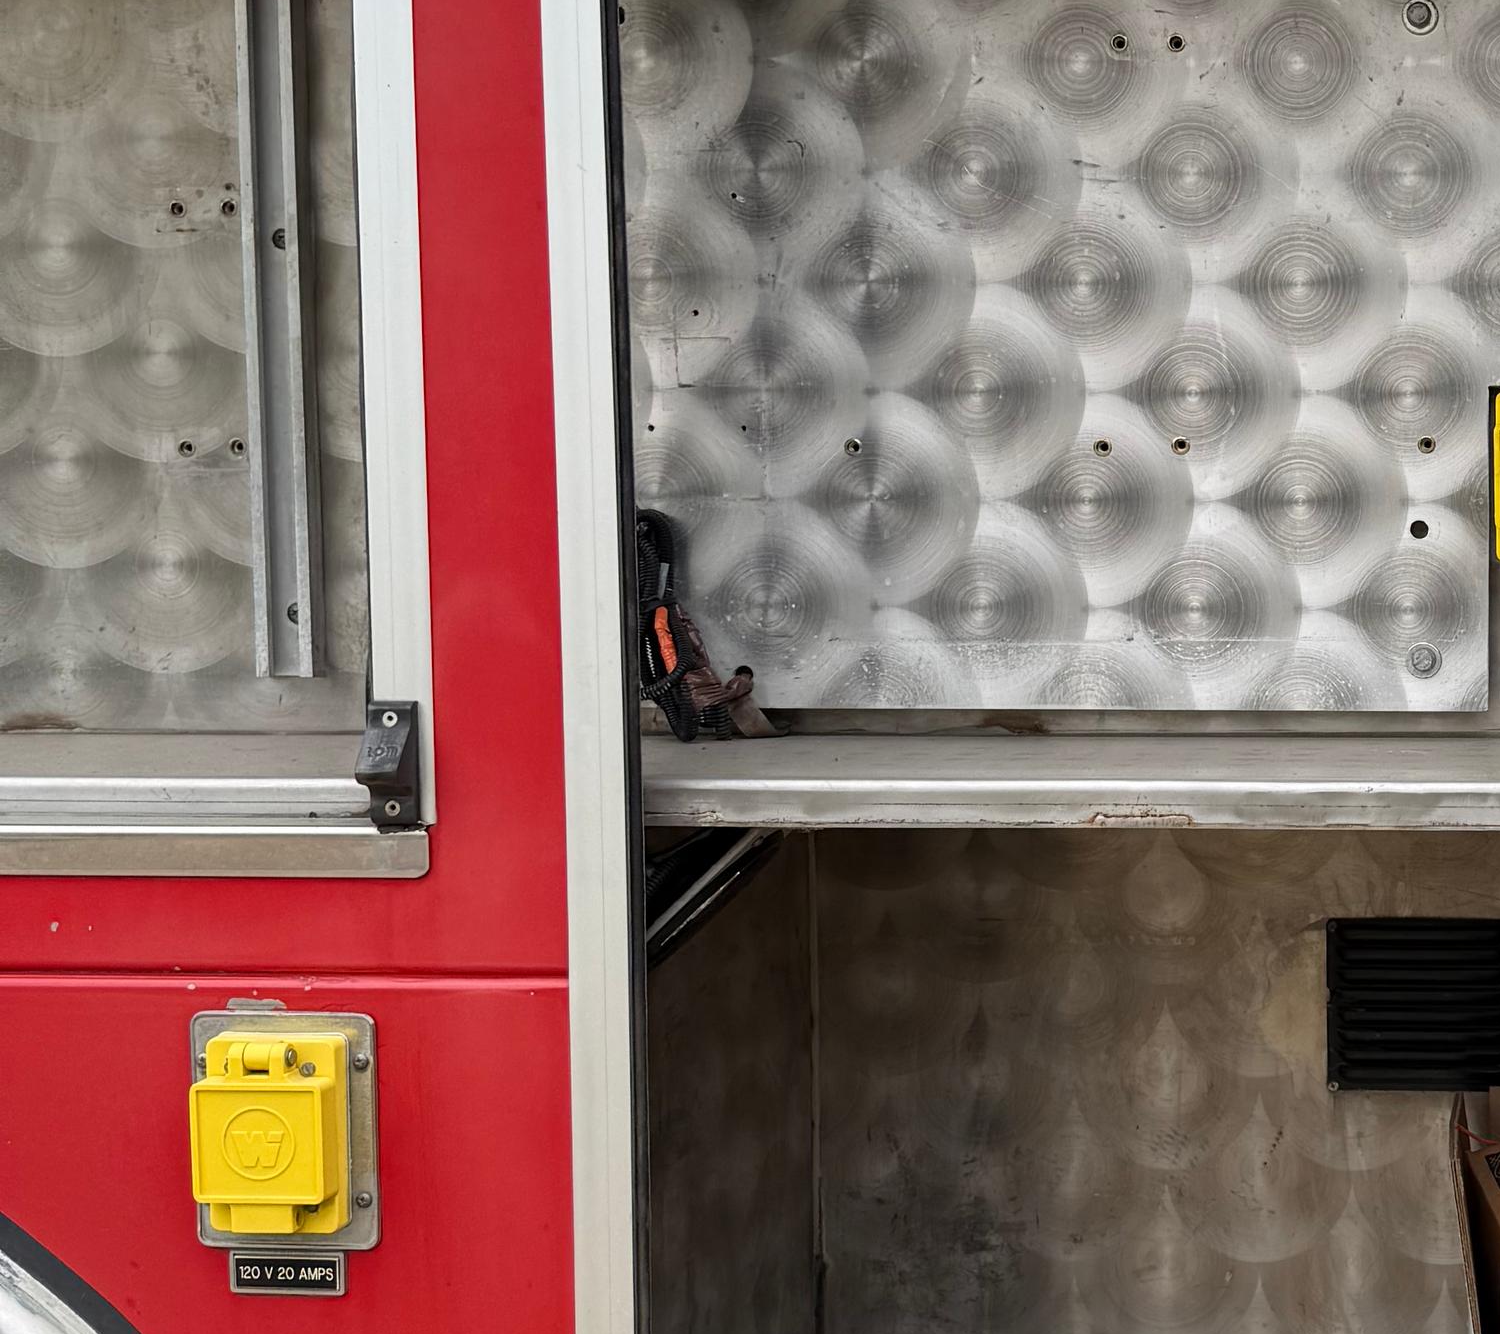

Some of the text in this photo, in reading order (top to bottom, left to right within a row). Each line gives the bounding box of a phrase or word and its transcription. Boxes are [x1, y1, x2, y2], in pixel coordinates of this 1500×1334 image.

[239, 1266, 334, 1281] 120 V 20 AMPS
